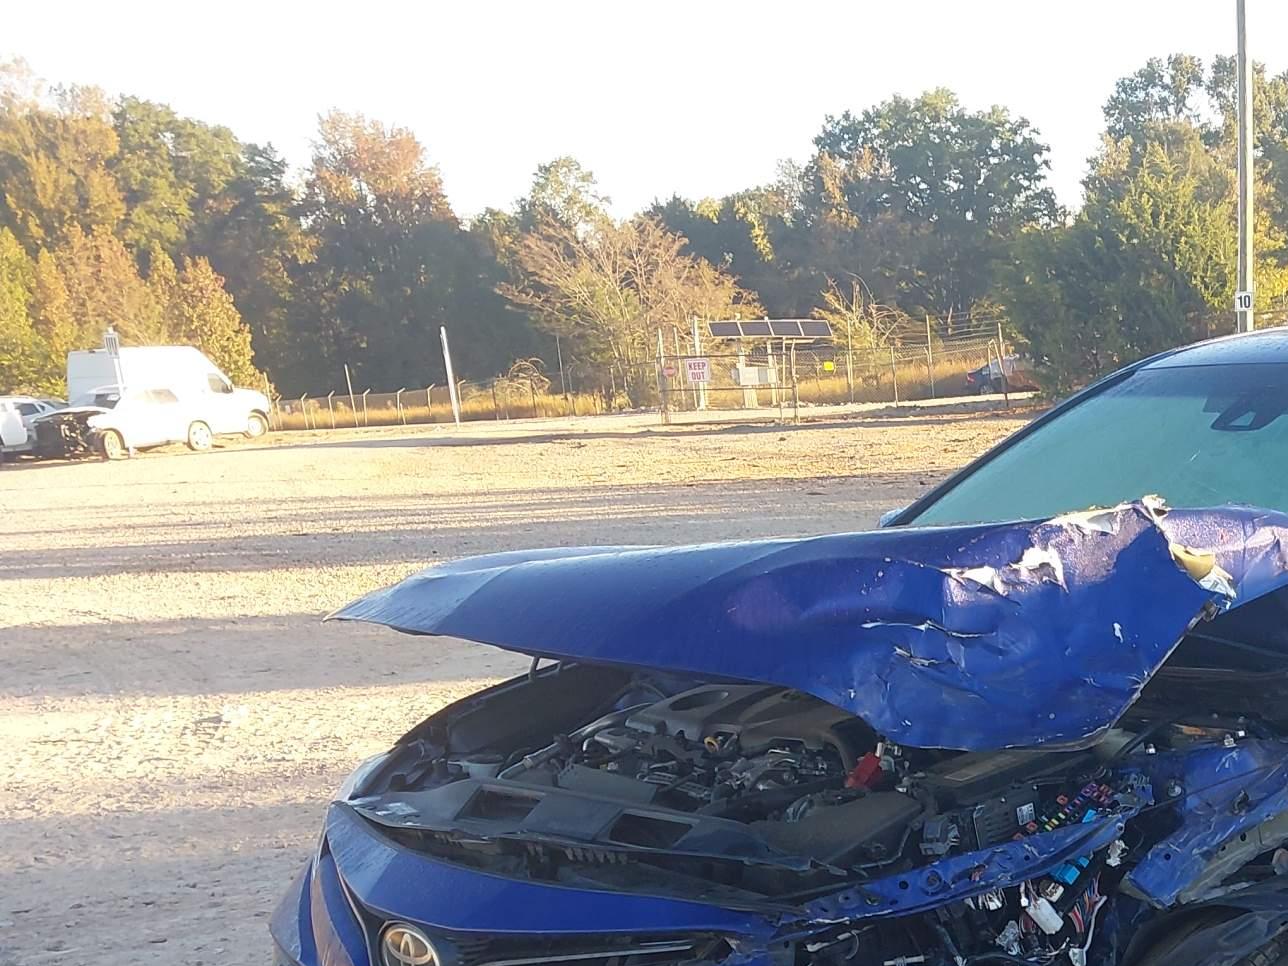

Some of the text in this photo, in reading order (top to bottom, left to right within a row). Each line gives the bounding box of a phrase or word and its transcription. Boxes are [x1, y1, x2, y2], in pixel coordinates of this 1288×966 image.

[1237, 295, 1251, 308] 10
[688, 362, 706, 370] KEEP
[691, 372, 705, 380] OUT
